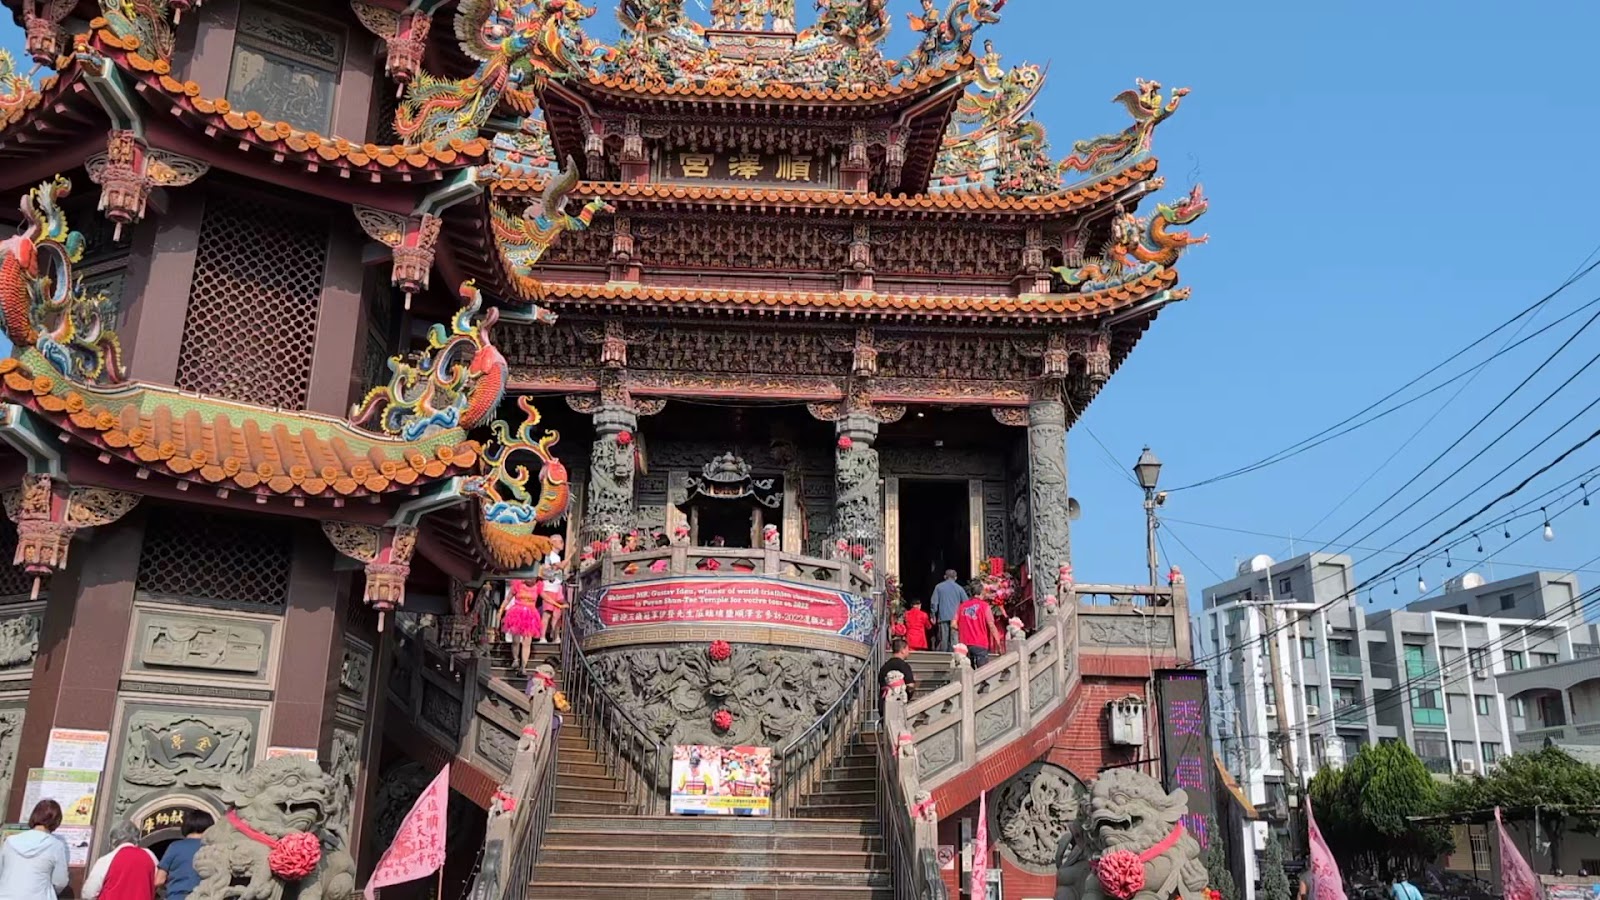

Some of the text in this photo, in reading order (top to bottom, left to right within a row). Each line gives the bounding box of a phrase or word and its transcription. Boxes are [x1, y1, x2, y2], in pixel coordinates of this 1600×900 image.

[651, 589, 675, 597] Gustav
[697, 587, 725, 595] winner
[727, 587, 735, 595] of
[698, 596, 729, 604] Temple
